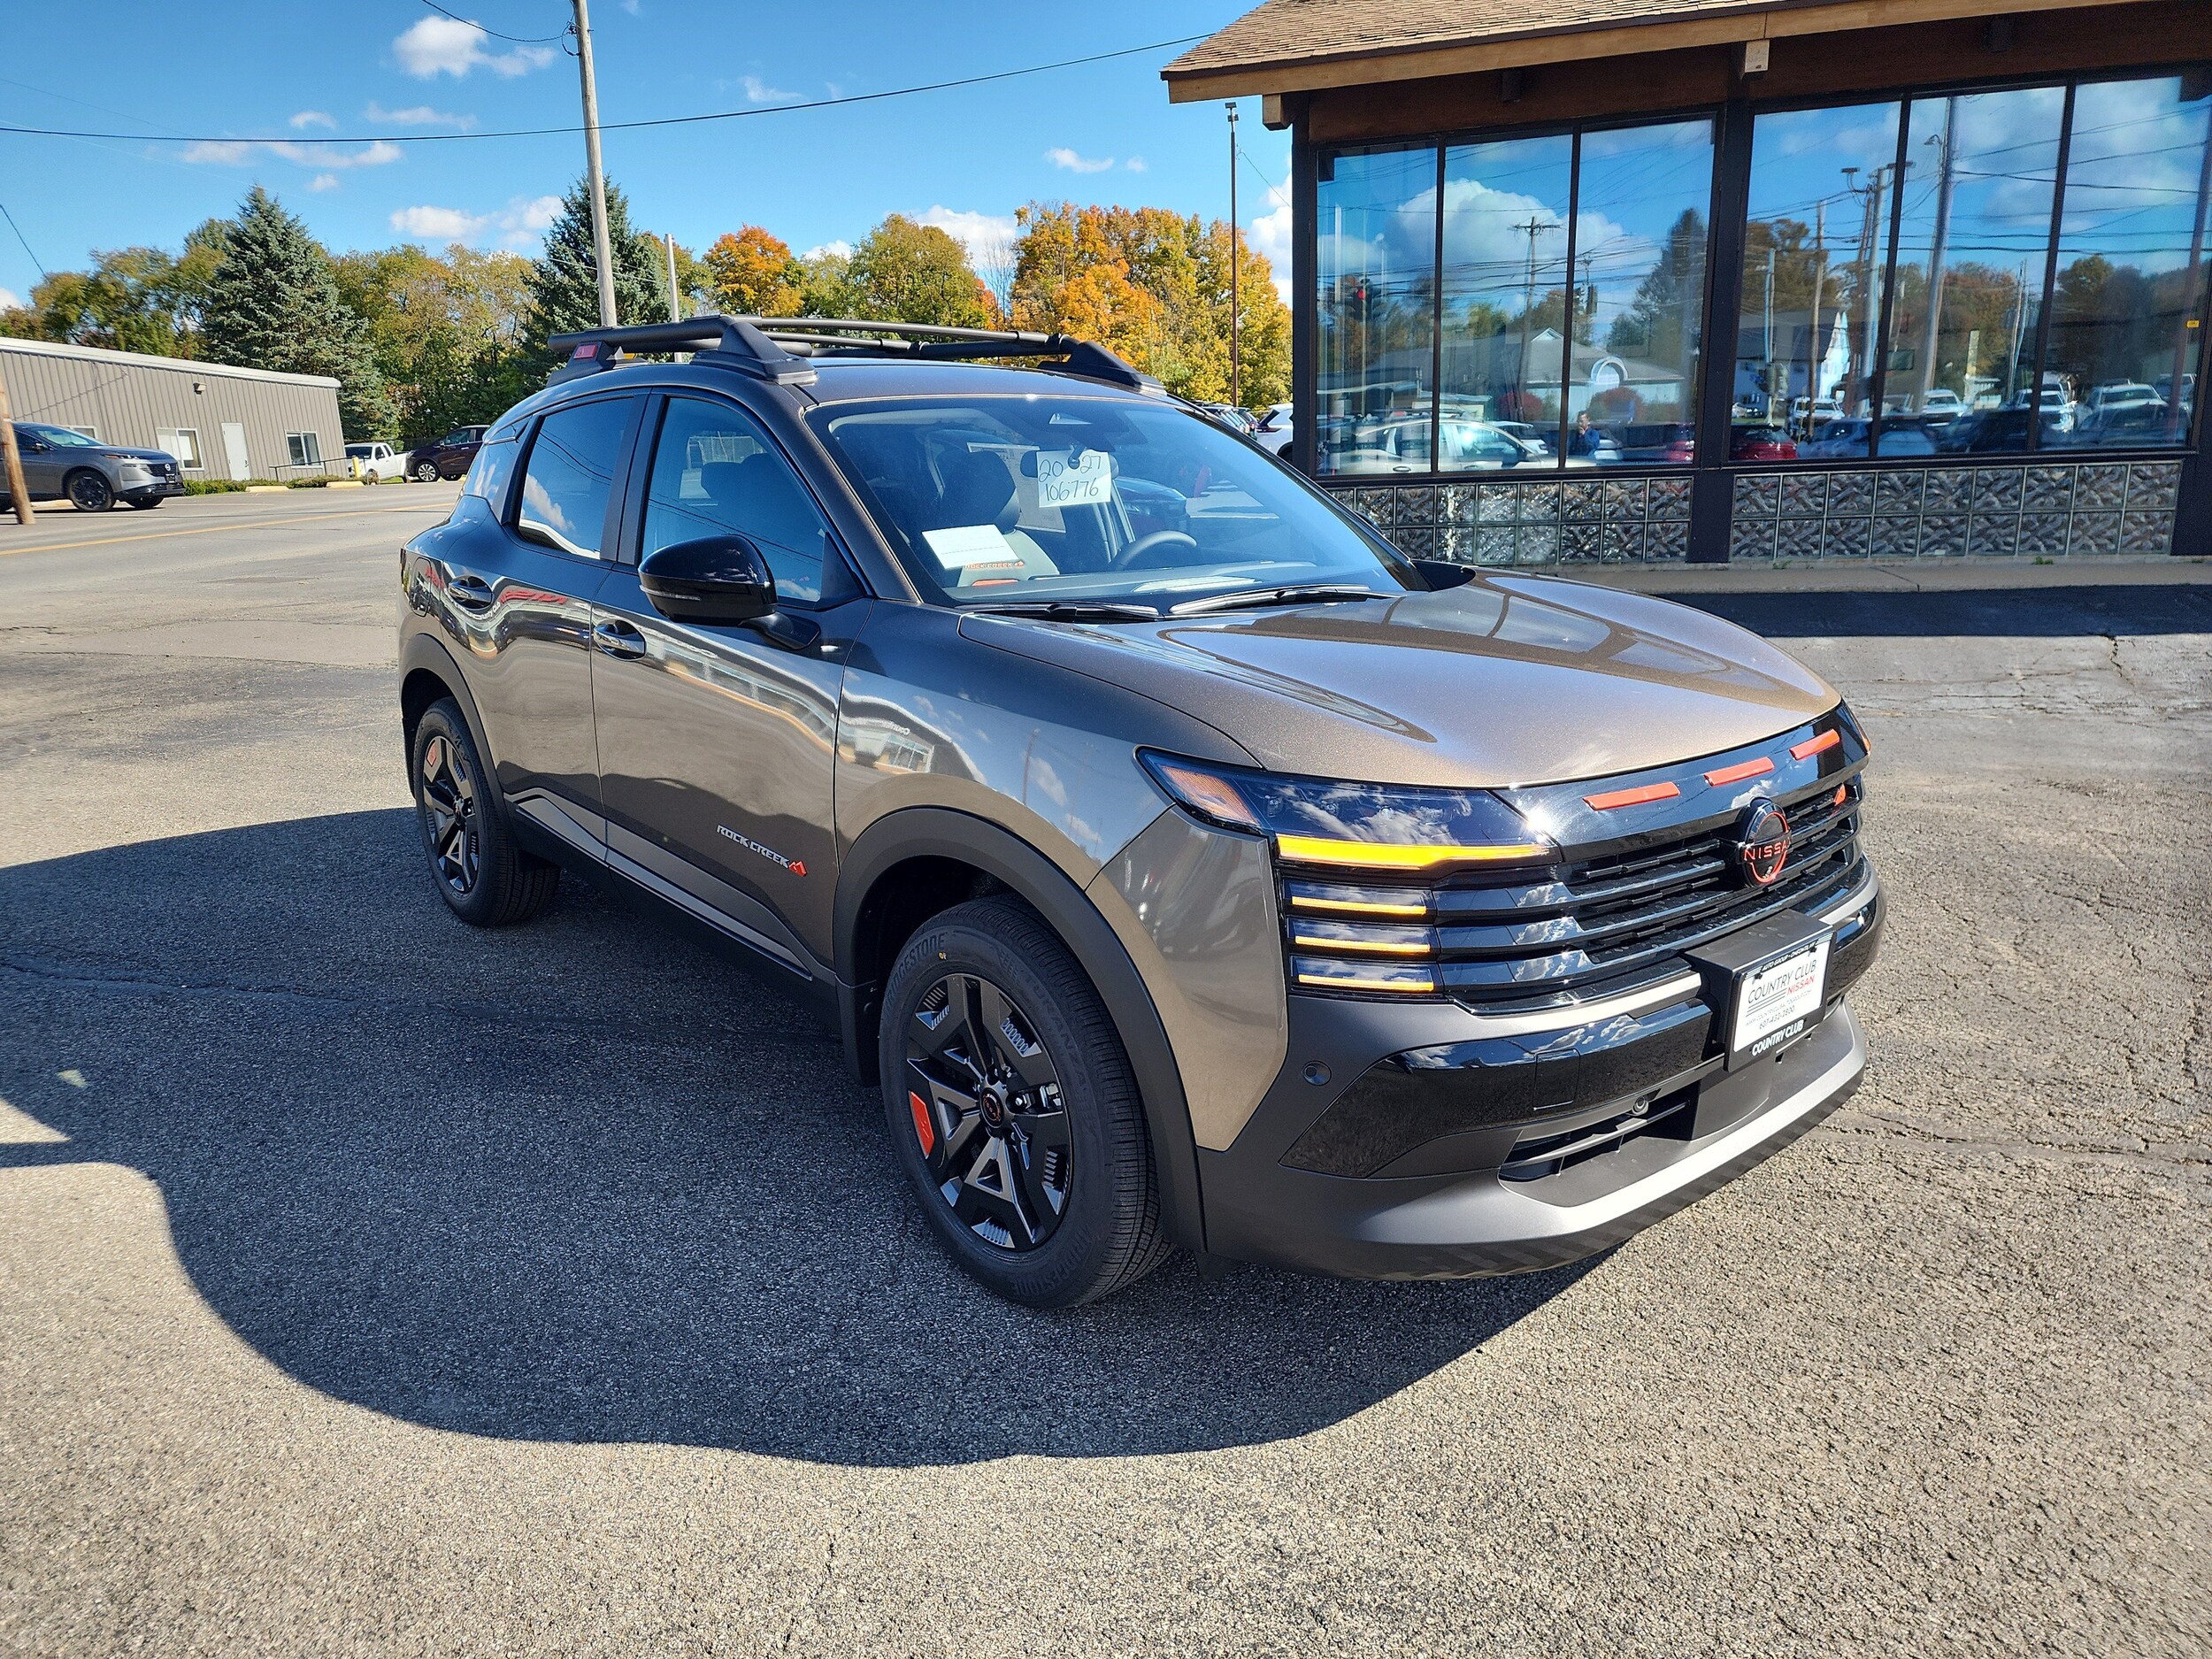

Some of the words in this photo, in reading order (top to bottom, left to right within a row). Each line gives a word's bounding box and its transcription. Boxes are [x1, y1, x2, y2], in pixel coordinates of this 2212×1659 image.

[1039, 459, 1064, 483] 20
[1080, 455, 1101, 473] 27
[1046, 478, 1098, 501] 106776
[716, 825, 749, 848] ROCK
[749, 841, 790, 868] CREEK
[1748, 972, 1793, 1003] COUNTRY
[1794, 960, 1816, 980] CLUB
[1786, 976, 1815, 995] NISSAN
[1752, 1028, 1789, 1056] COUNTRY
[1786, 1019, 1804, 1039] CLUB
